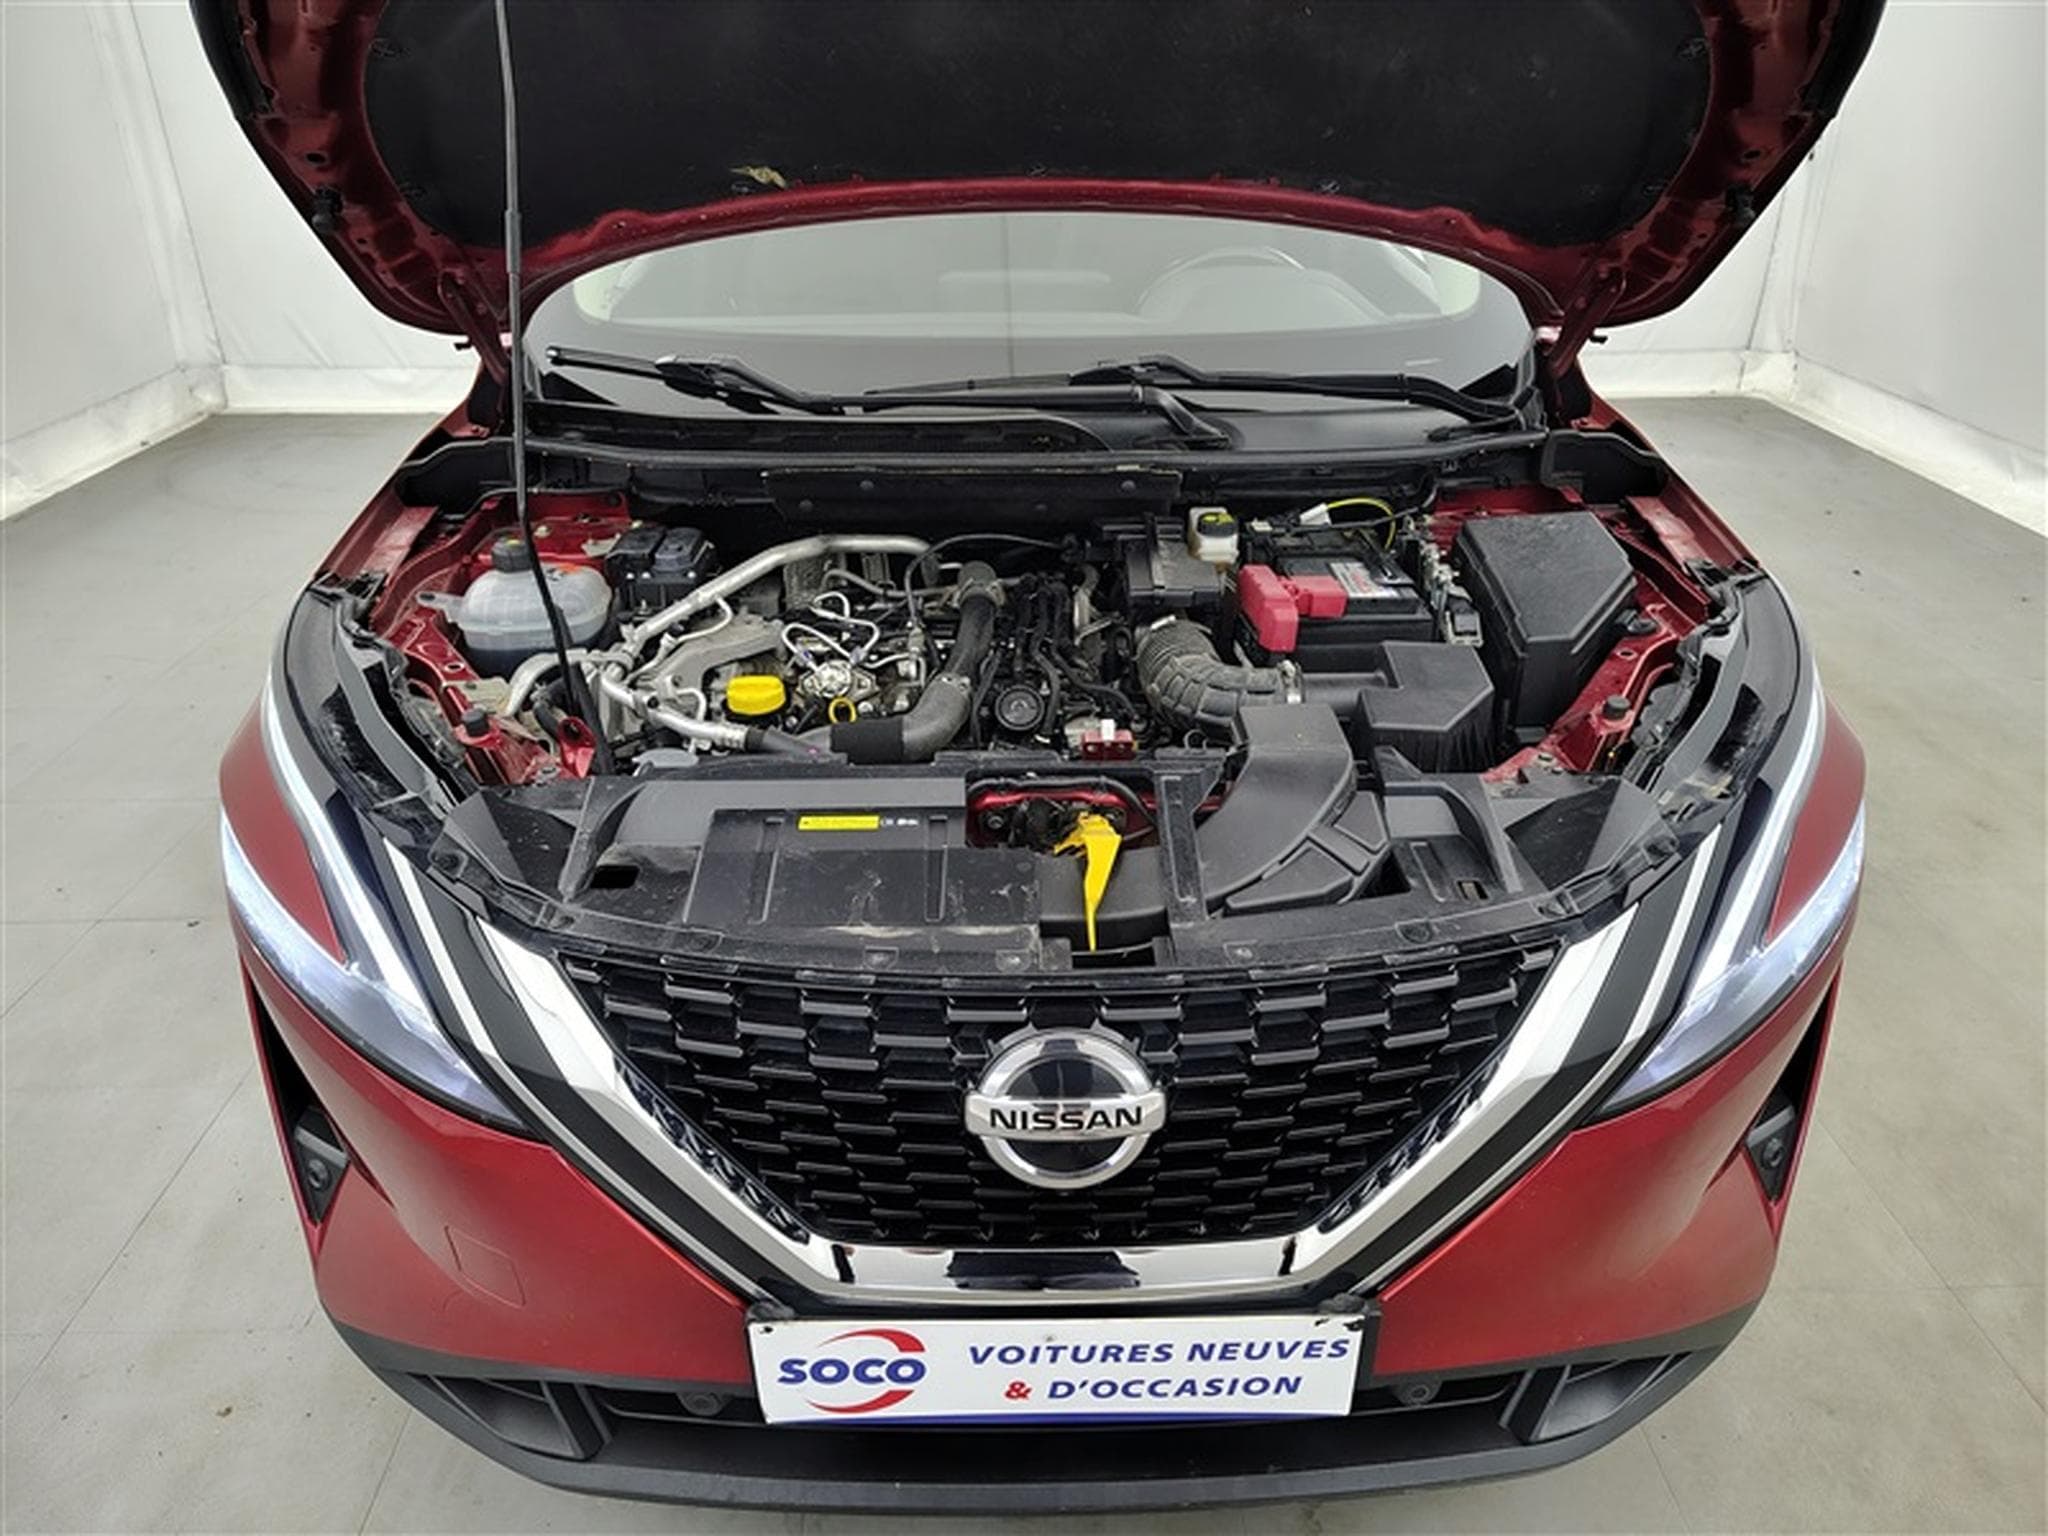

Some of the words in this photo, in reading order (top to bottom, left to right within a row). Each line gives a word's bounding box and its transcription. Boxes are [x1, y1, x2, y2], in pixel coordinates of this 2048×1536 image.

[989, 1106, 1142, 1131] NISSAN
[969, 1343, 1174, 1365] VOITURES
[1187, 1339, 1350, 1361] NEUVES
[777, 1358, 926, 1384] SOCO
[1005, 1381, 1032, 1401] &
[1047, 1375, 1302, 1400] D'OCCASION
